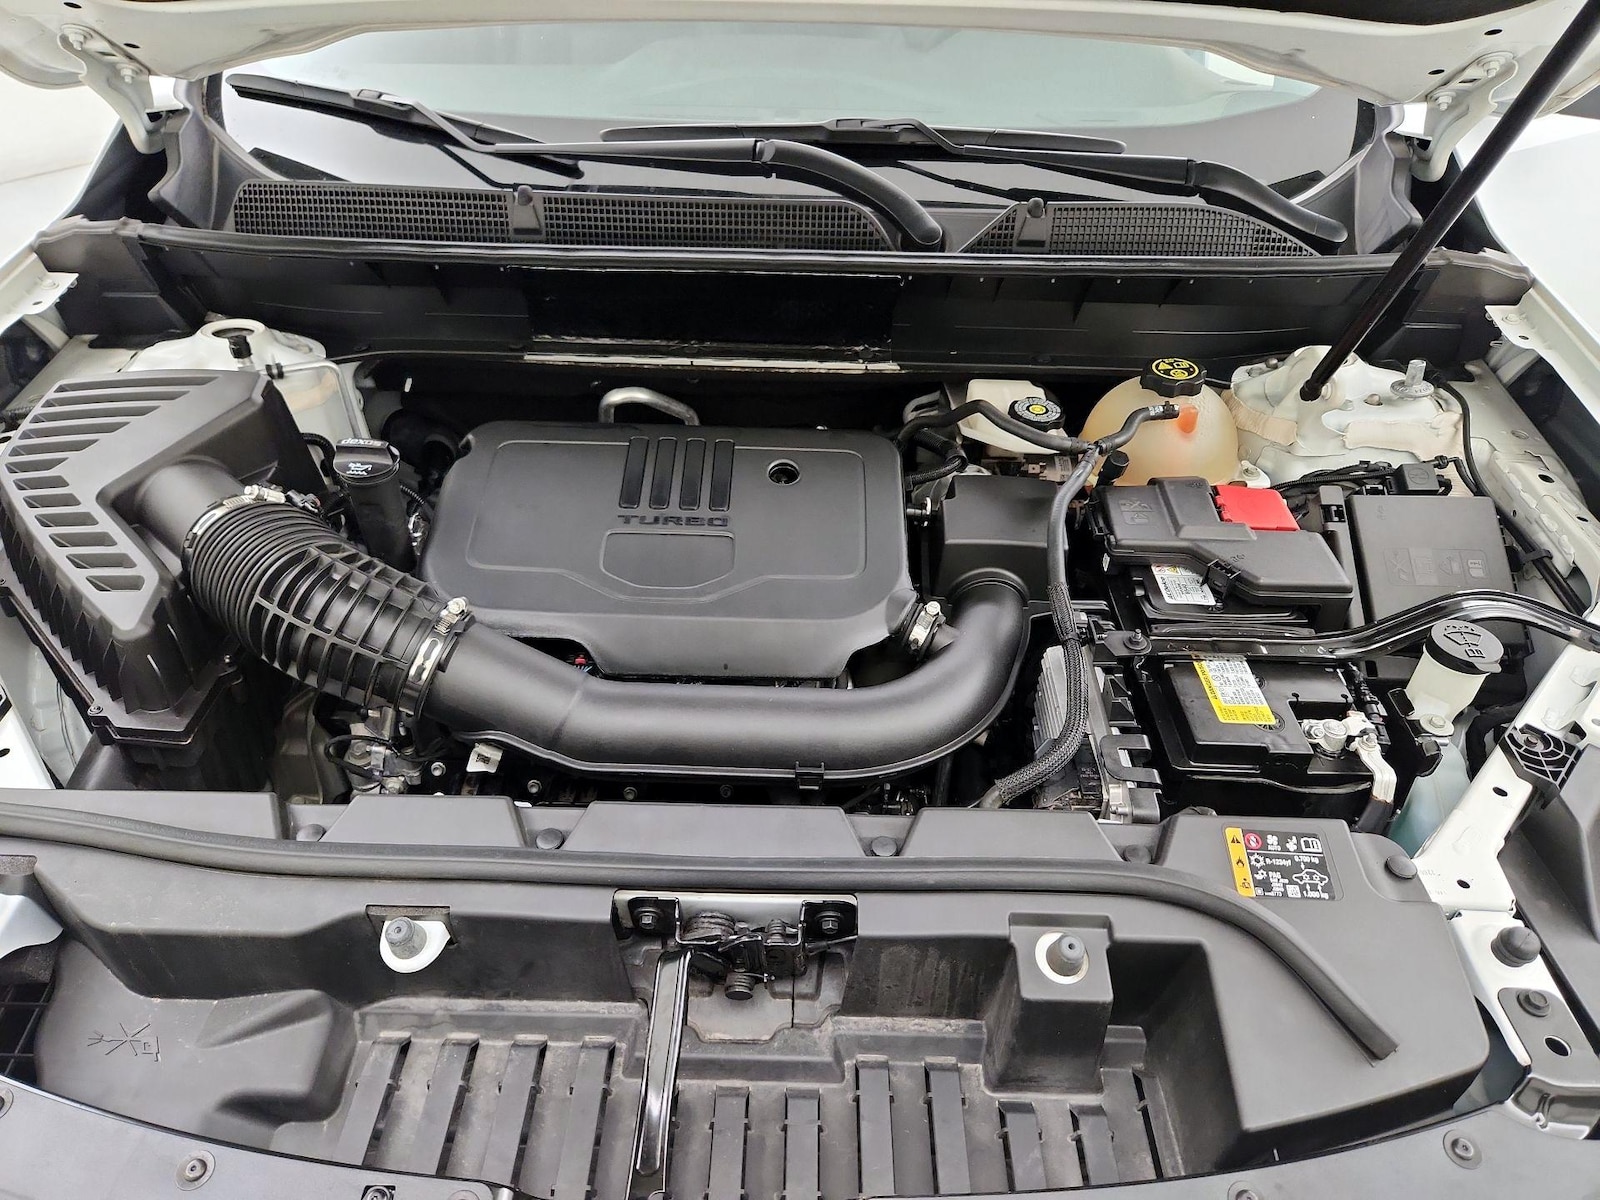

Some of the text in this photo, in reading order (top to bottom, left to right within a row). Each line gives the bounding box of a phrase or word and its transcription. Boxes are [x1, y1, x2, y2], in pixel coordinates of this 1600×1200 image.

[341, 438, 381, 446] dexos
[618, 515, 728, 527] TURBO
[1265, 857, 1292, 866] R-1234yf
[1294, 855, 1319, 864] 0.700 kg
